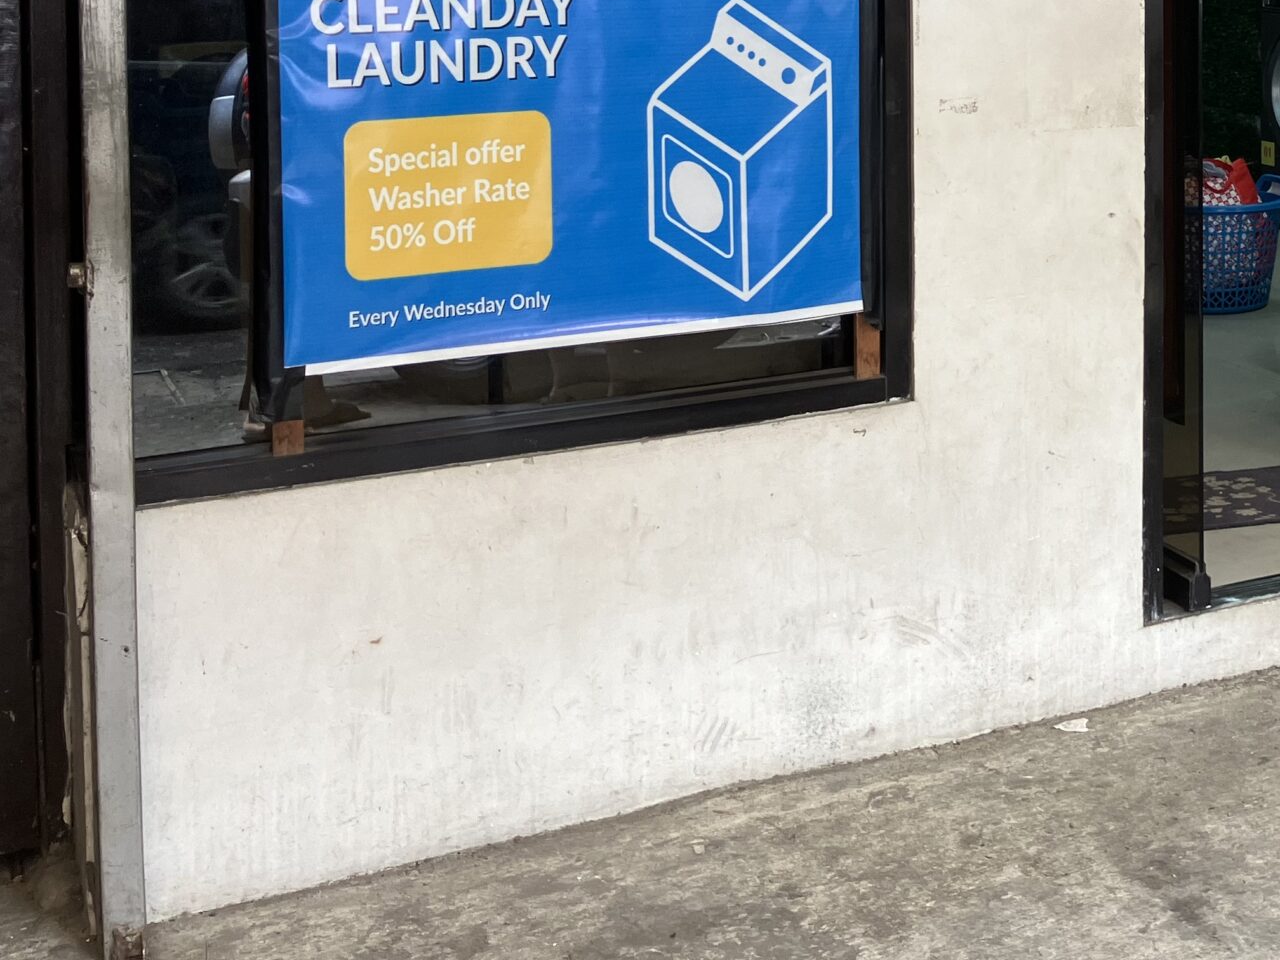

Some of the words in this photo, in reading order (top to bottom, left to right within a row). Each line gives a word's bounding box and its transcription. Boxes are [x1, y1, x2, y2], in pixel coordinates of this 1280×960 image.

[324, 33, 569, 90] LAUNDRY
[368, 142, 459, 179] Special
[464, 140, 526, 166] offer
[368, 181, 469, 212] Washer
[473, 176, 531, 204] Rate
[369, 222, 427, 253] 50%
[432, 216, 477, 245] Off
[347, 310, 400, 332] Every
[402, 296, 507, 324] Wednesday
[509, 290, 552, 317] Only
